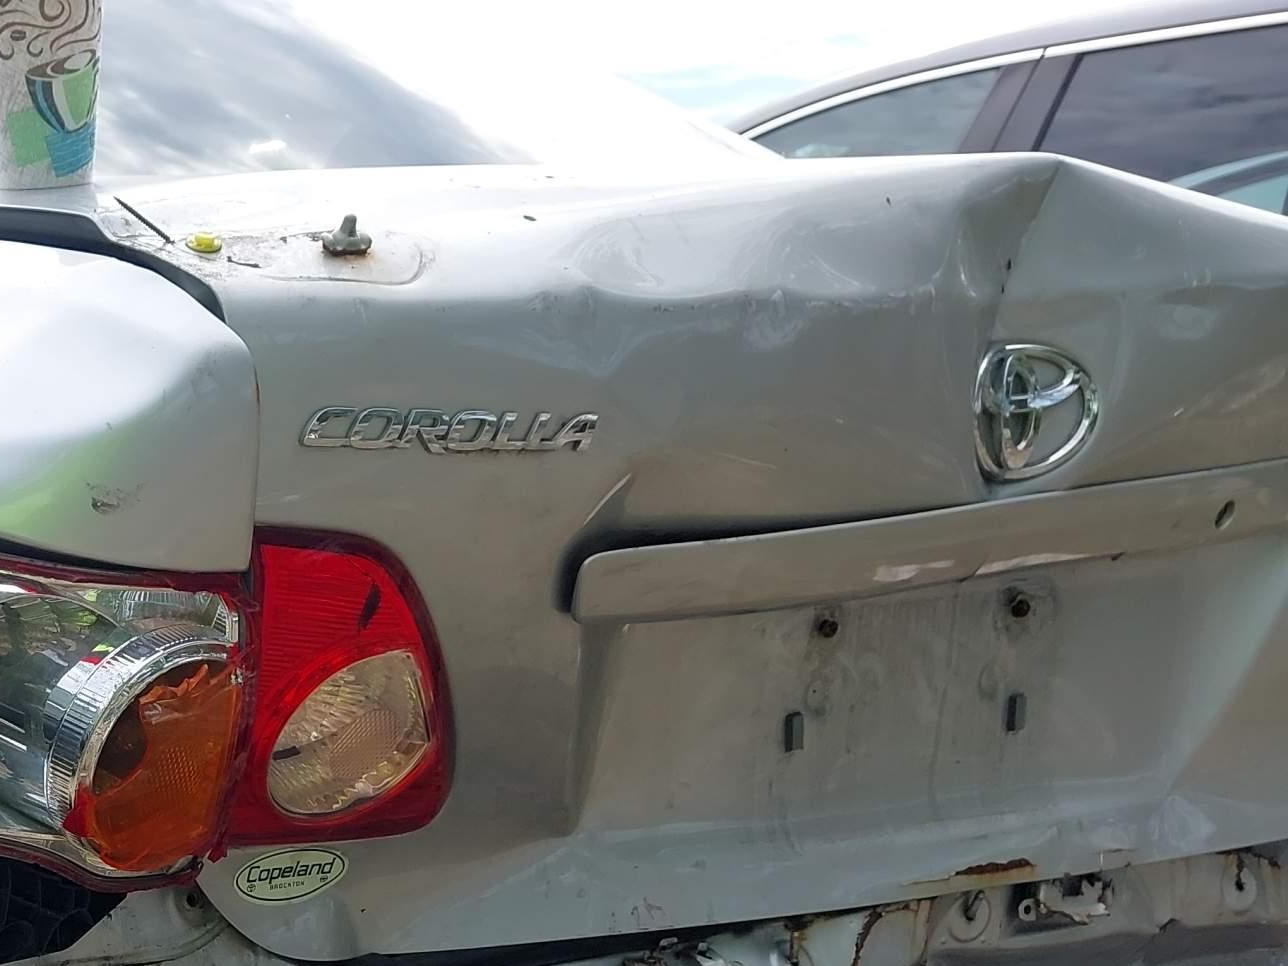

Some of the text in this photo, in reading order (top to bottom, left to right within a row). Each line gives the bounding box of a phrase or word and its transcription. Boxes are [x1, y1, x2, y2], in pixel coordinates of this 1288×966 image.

[299, 406, 599, 454] COROLLA
[246, 857, 337, 884] Copeland
[269, 881, 305, 890] BROCKTON
